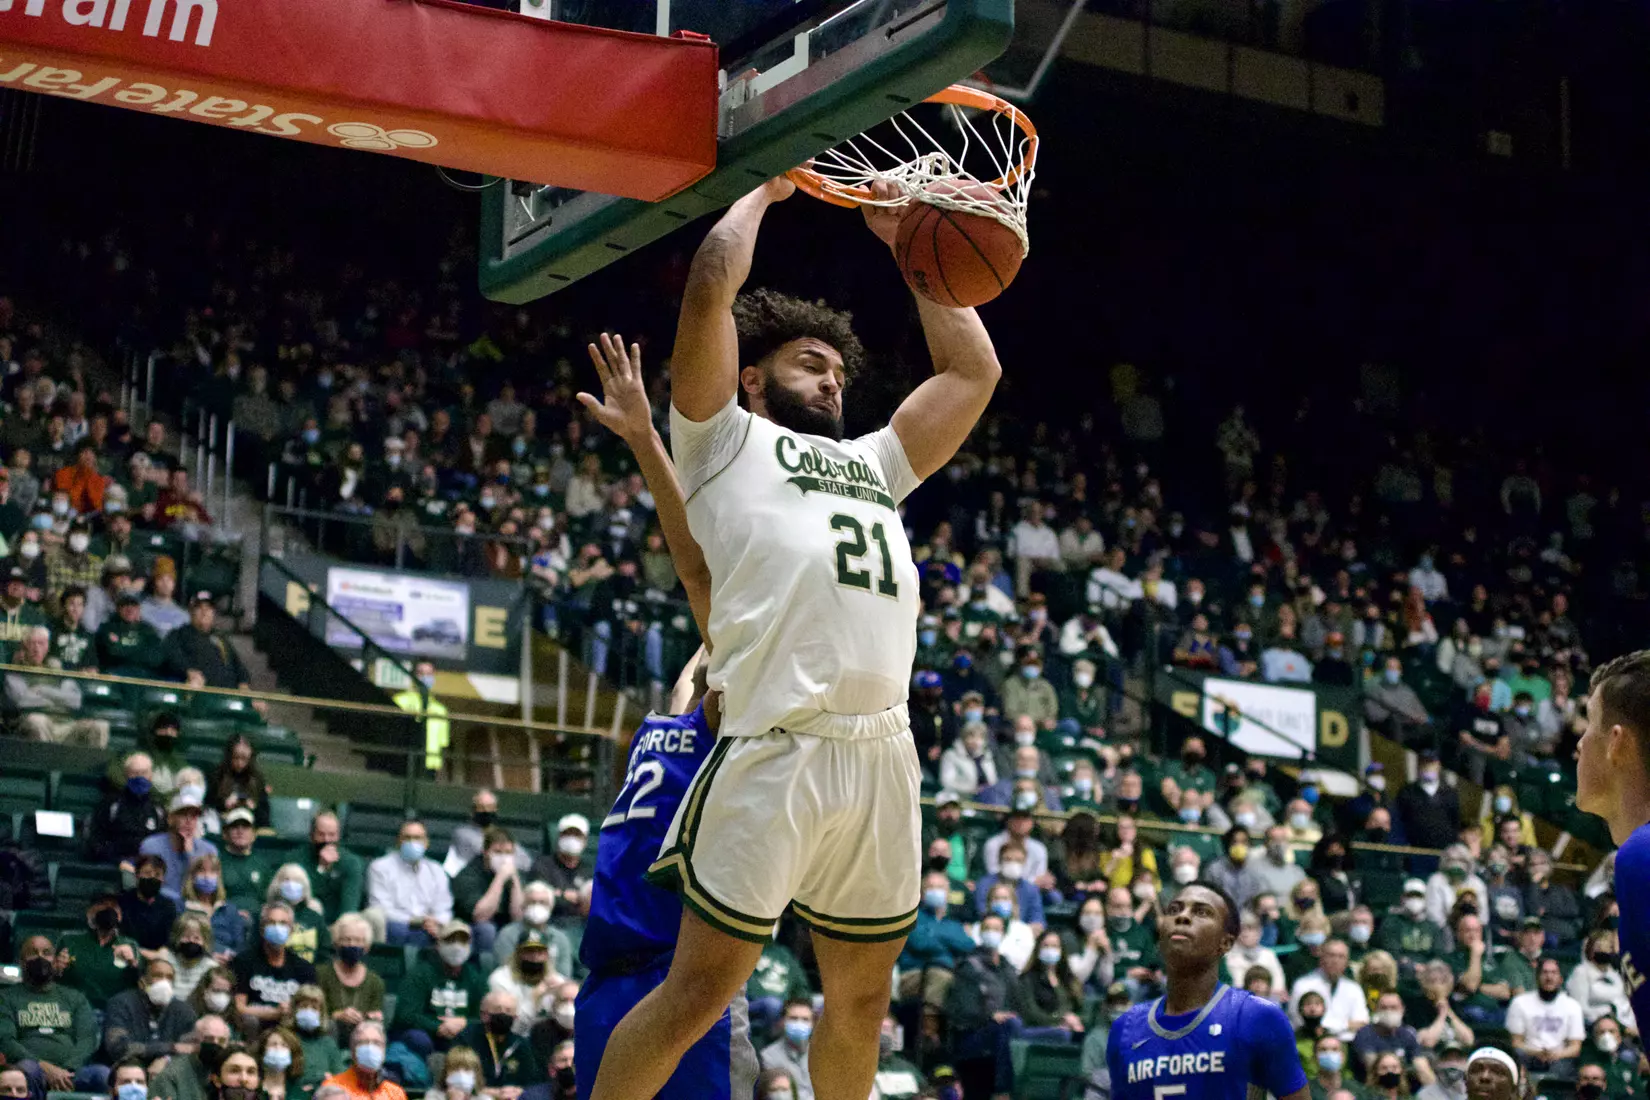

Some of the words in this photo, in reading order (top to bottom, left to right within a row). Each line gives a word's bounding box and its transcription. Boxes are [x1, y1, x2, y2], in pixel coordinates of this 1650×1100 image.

[24, 0, 219, 47] arm
[0, 58, 122, 99] Far
[115, 82, 324, 135] State
[776, 435, 887, 492] Colorado
[818, 479, 851, 497] STATE
[856, 486, 879, 503] UNIV
[828, 511, 899, 602] 21
[474, 605, 507, 649] E
[1320, 709, 1349, 747] D
[1127, 1058, 1154, 1084] AIR
[1156, 1051, 1225, 1077] FORCE
